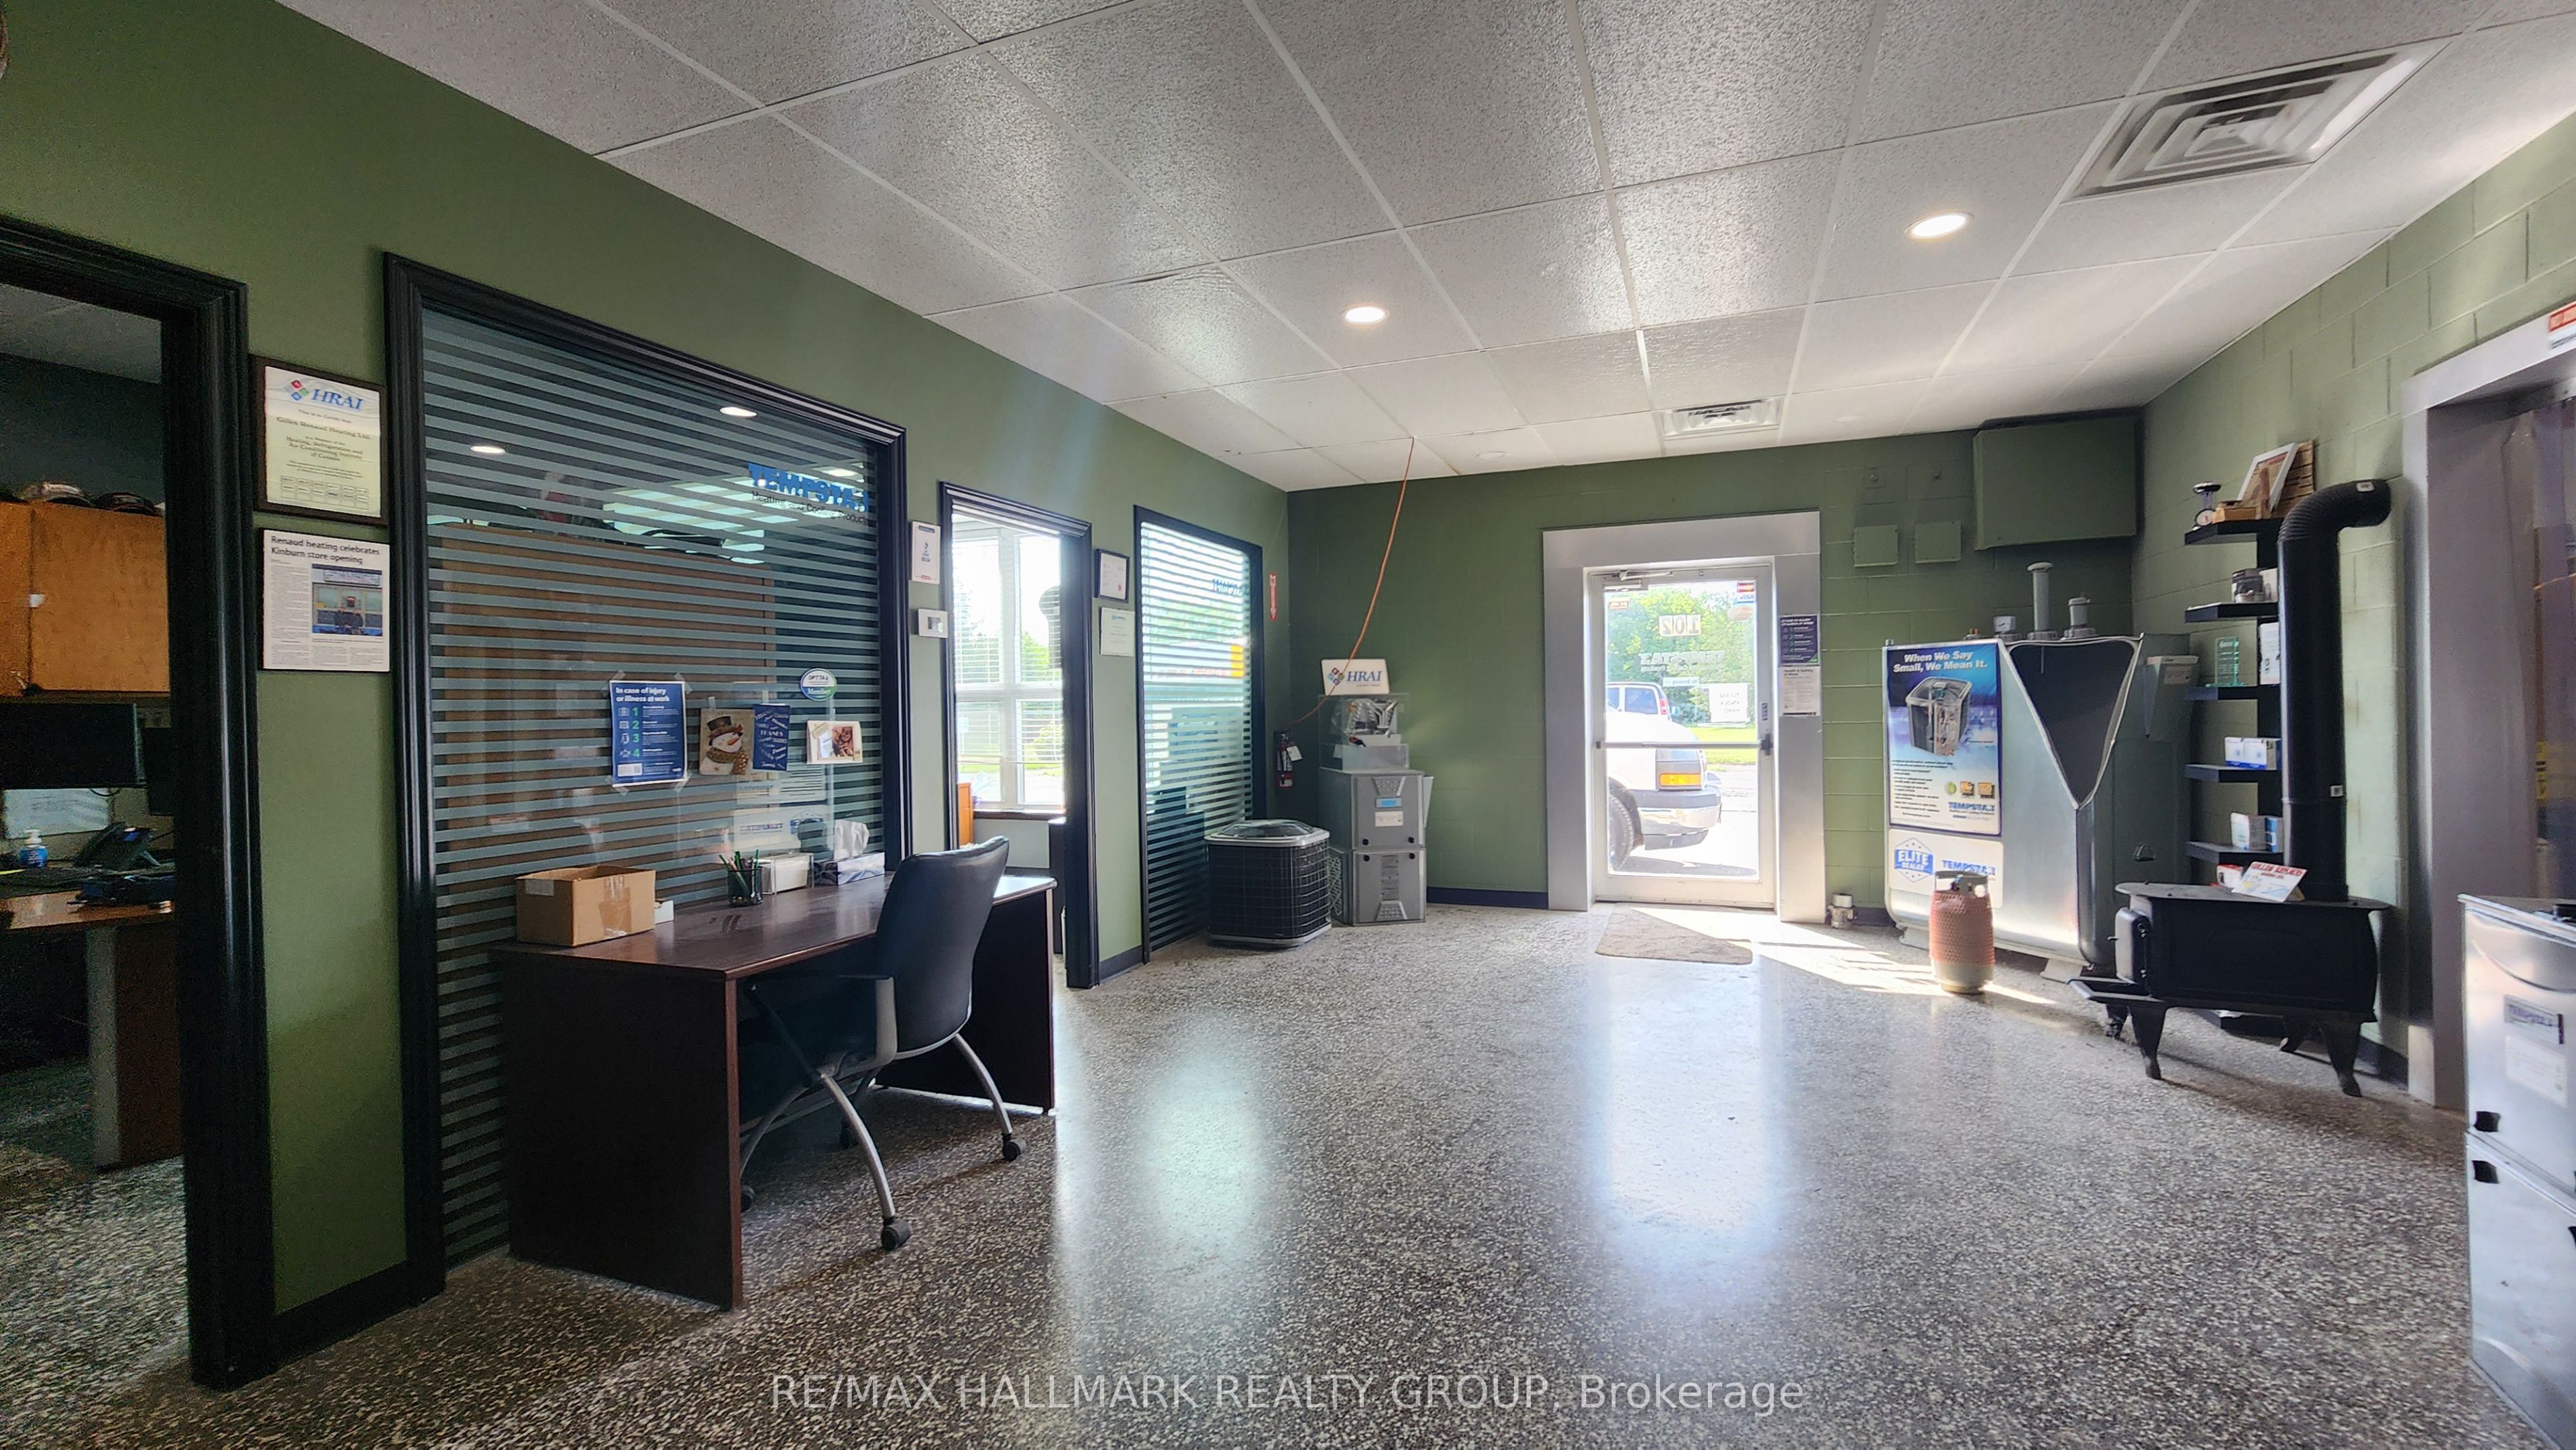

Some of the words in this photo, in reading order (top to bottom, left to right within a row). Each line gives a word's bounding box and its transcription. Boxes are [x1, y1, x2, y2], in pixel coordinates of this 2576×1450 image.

[311, 389, 364, 410] HRAI
[752, 491, 786, 508] Heating
[270, 536, 304, 547] Renaud
[306, 539, 338, 553] heating
[340, 545, 380, 556] celebrates
[271, 547, 305, 558] Kinburn
[307, 552, 328, 560] store
[330, 556, 363, 565] opening
[1904, 653, 1932, 663] When
[1934, 652, 1950, 661] We
[1952, 650, 1973, 660] Say
[1893, 663, 1924, 673] Small,
[1926, 662, 1942, 671] We
[1944, 660, 1972, 670] Mean
[1975, 660, 1988, 668] It.
[1347, 671, 1382, 682] HRAI
[649, 687, 666, 695] injury
[632, 707, 638, 717] 1
[632, 721, 640, 729] 2
[633, 733, 640, 743] 3
[633, 748, 641, 758] 4
[1898, 850, 1929, 865] ELITE
